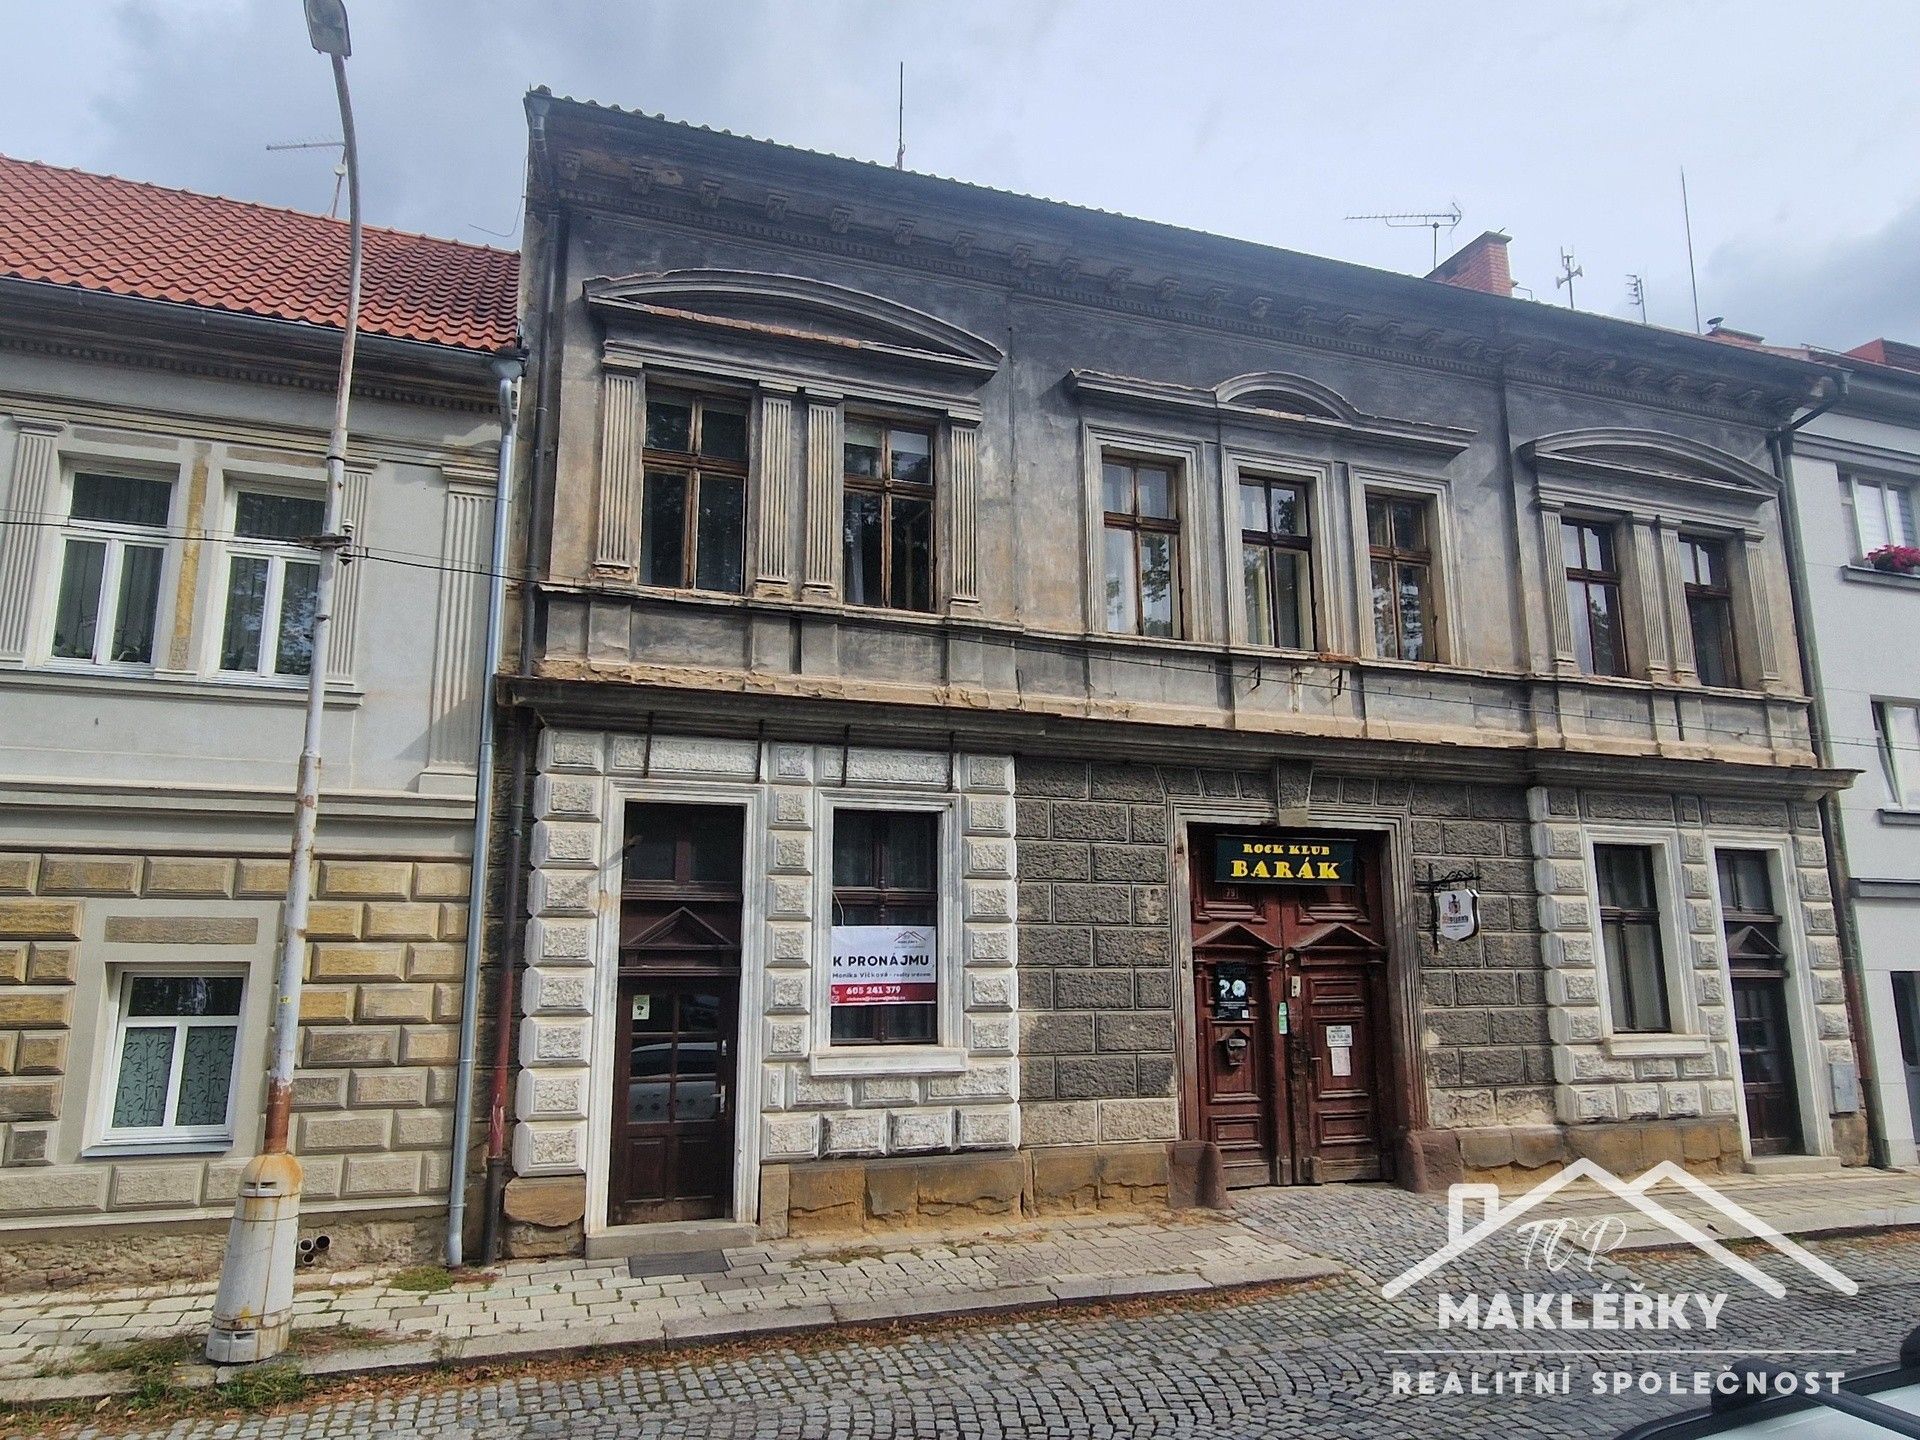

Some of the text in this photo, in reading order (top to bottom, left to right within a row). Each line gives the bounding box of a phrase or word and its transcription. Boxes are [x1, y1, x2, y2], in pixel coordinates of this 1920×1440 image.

[1243, 843, 1330, 855] ROCK KLUB
[1230, 856, 1340, 879] BARÁK
[832, 953, 930, 967] K PRONÁJMU
